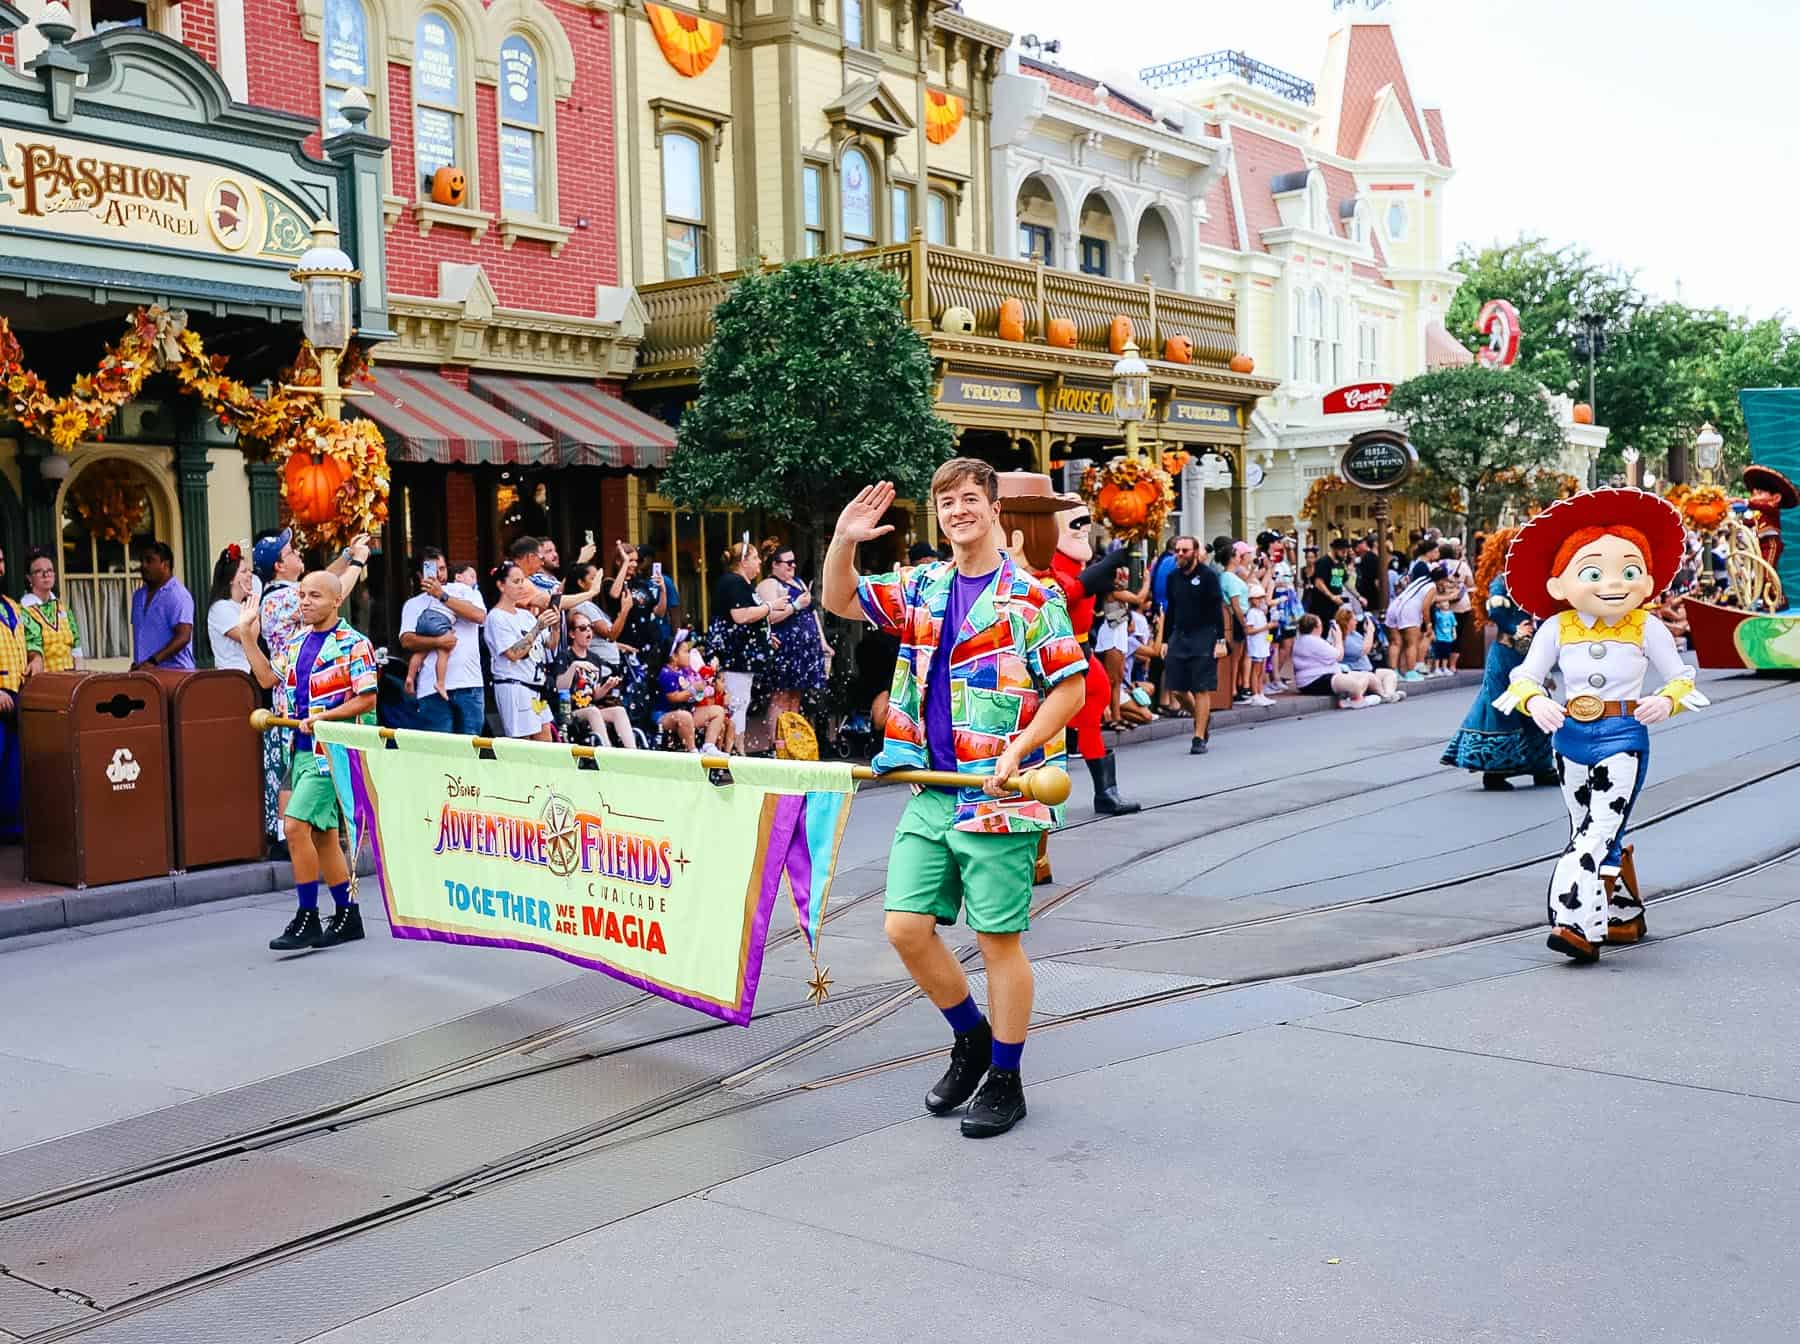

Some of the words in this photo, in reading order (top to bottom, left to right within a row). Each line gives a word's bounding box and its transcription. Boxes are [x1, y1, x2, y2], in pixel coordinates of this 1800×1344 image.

[8, 142, 190, 216] FASHION
[97, 199, 200, 236] APPAREL
[961, 382, 1021, 402] TRICKS
[1057, 388, 1099, 413] HOUSE
[433, 801, 550, 866] ADVENTURE
[574, 811, 674, 888] FRIENDS
[444, 879, 553, 931] TOGETHER
[556, 904, 576, 919] WE
[555, 919, 578, 936] ARE
[582, 905, 668, 954] MAGIA
